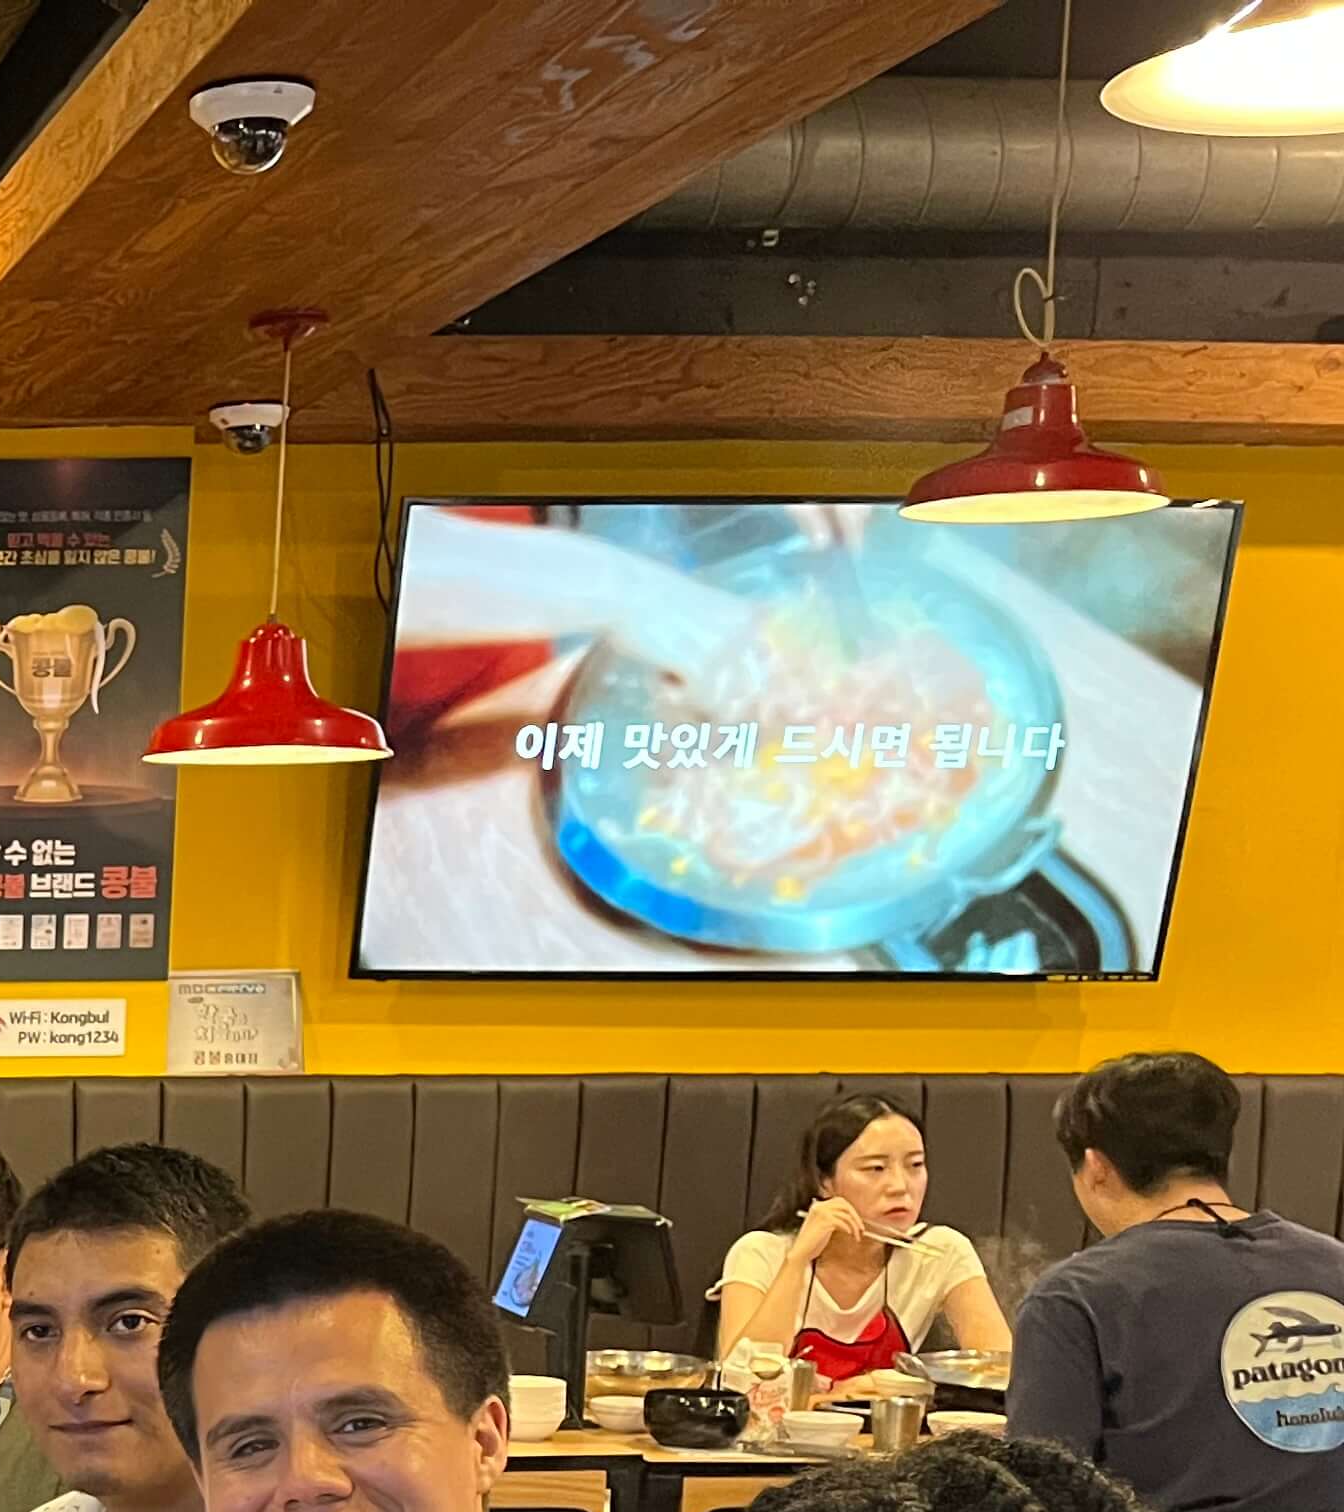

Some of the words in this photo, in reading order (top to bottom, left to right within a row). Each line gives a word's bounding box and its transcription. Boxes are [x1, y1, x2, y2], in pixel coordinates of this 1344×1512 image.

[515, 720, 605, 771] 이제
[622, 721, 759, 770] 맛있게
[774, 721, 913, 769] 드시면
[928, 721, 1067, 772] 됩니다
[3, 839, 28, 867] 수
[31, 839, 76, 866] 없는
[29, 872, 96, 899] 브랜드
[100, 865, 158, 899] 콩불
[9, 1011, 42, 1025] Wi-Fi
[50, 1010, 110, 1027] Kongbul
[18, 1031, 41, 1044] PW
[49, 1030, 119, 1046] kong1234
